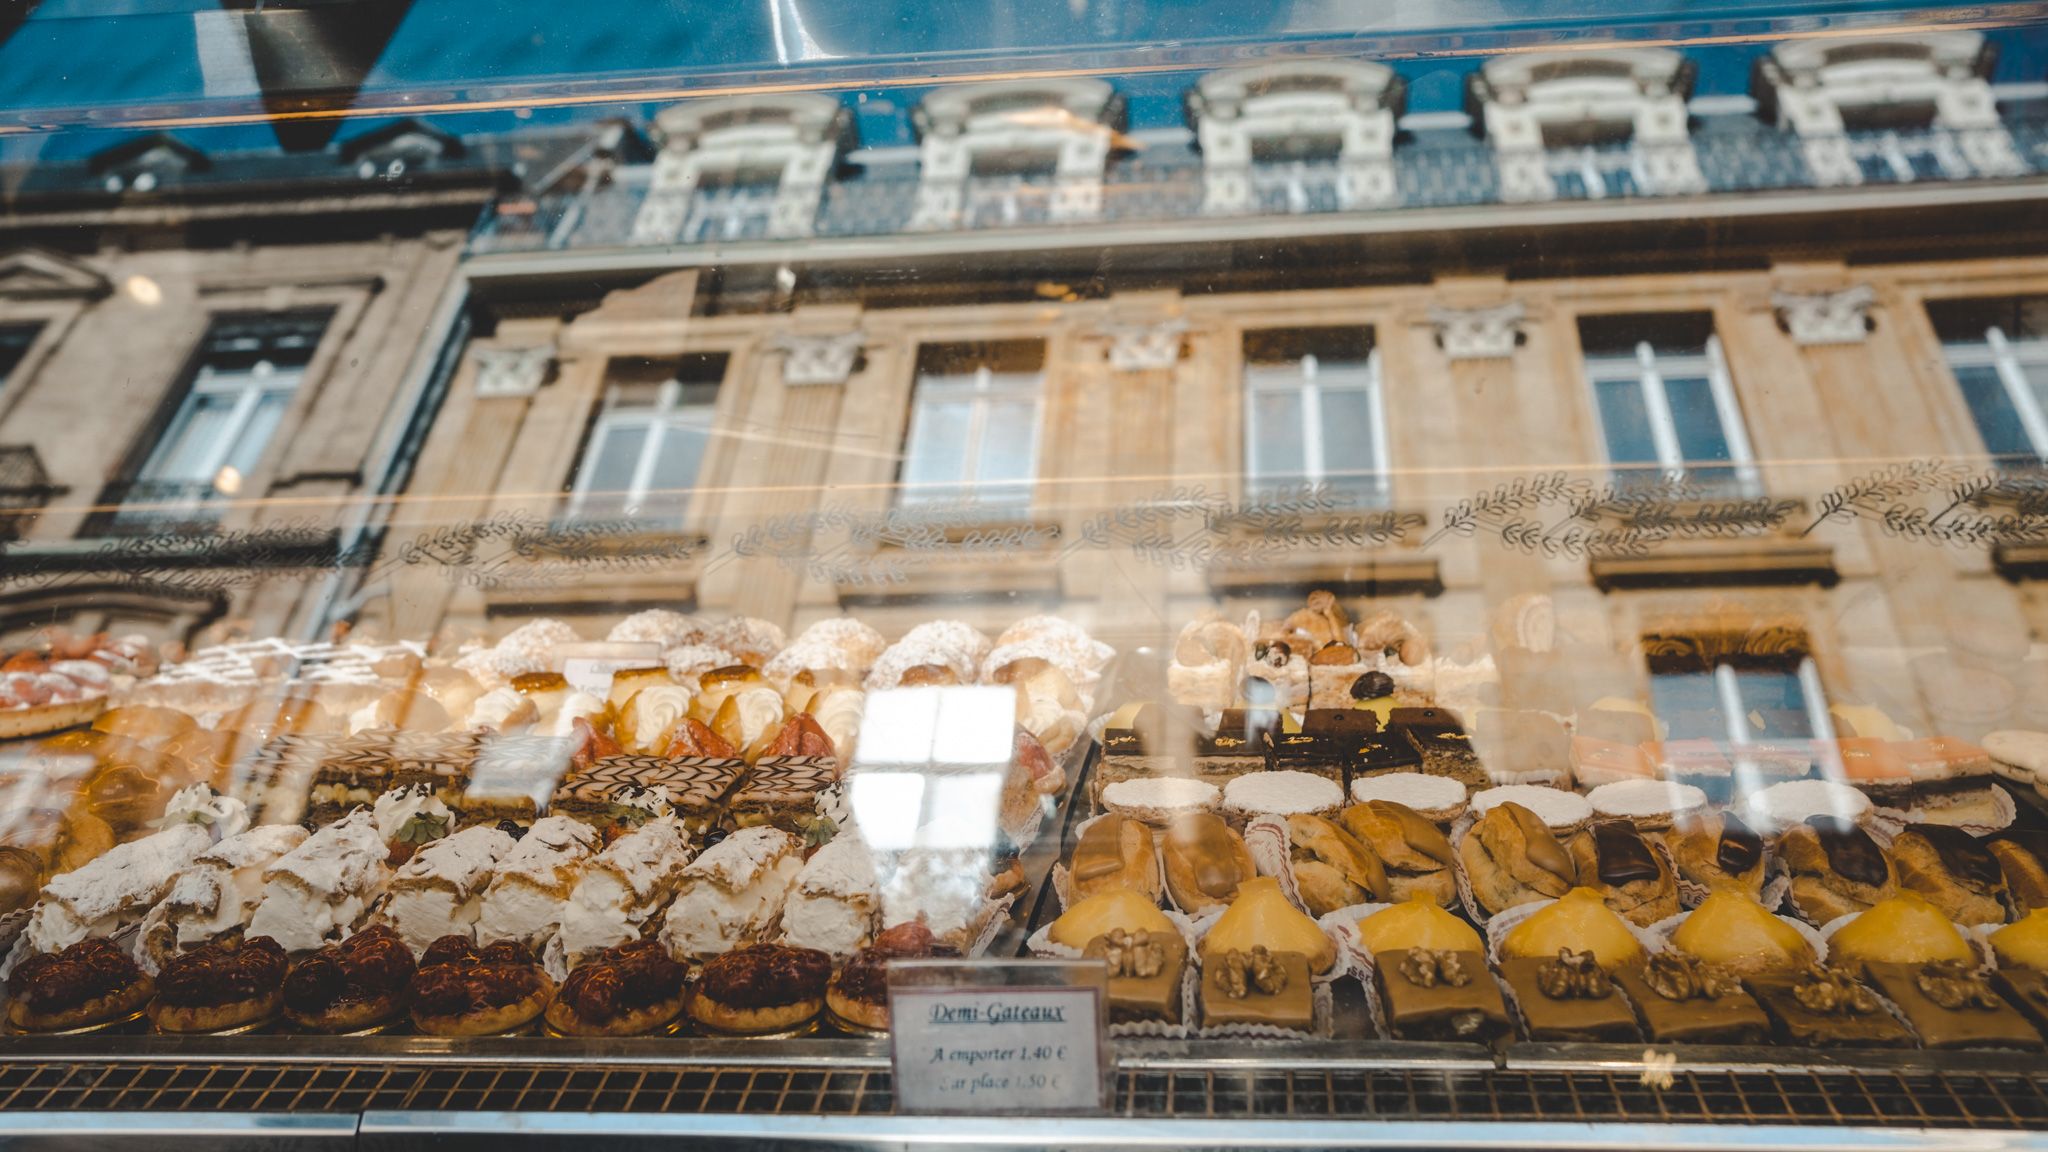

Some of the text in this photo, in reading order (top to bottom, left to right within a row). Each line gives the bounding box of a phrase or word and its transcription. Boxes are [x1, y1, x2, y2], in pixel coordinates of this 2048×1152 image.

[928, 1001, 1067, 1024] Demi-Gateaux
[929, 1044, 1069, 1066] A emporter 1.40 €
[970, 1072, 1010, 1095] place
[1015, 1073, 1047, 1090] 1.50
[1051, 1073, 1062, 1090] €
